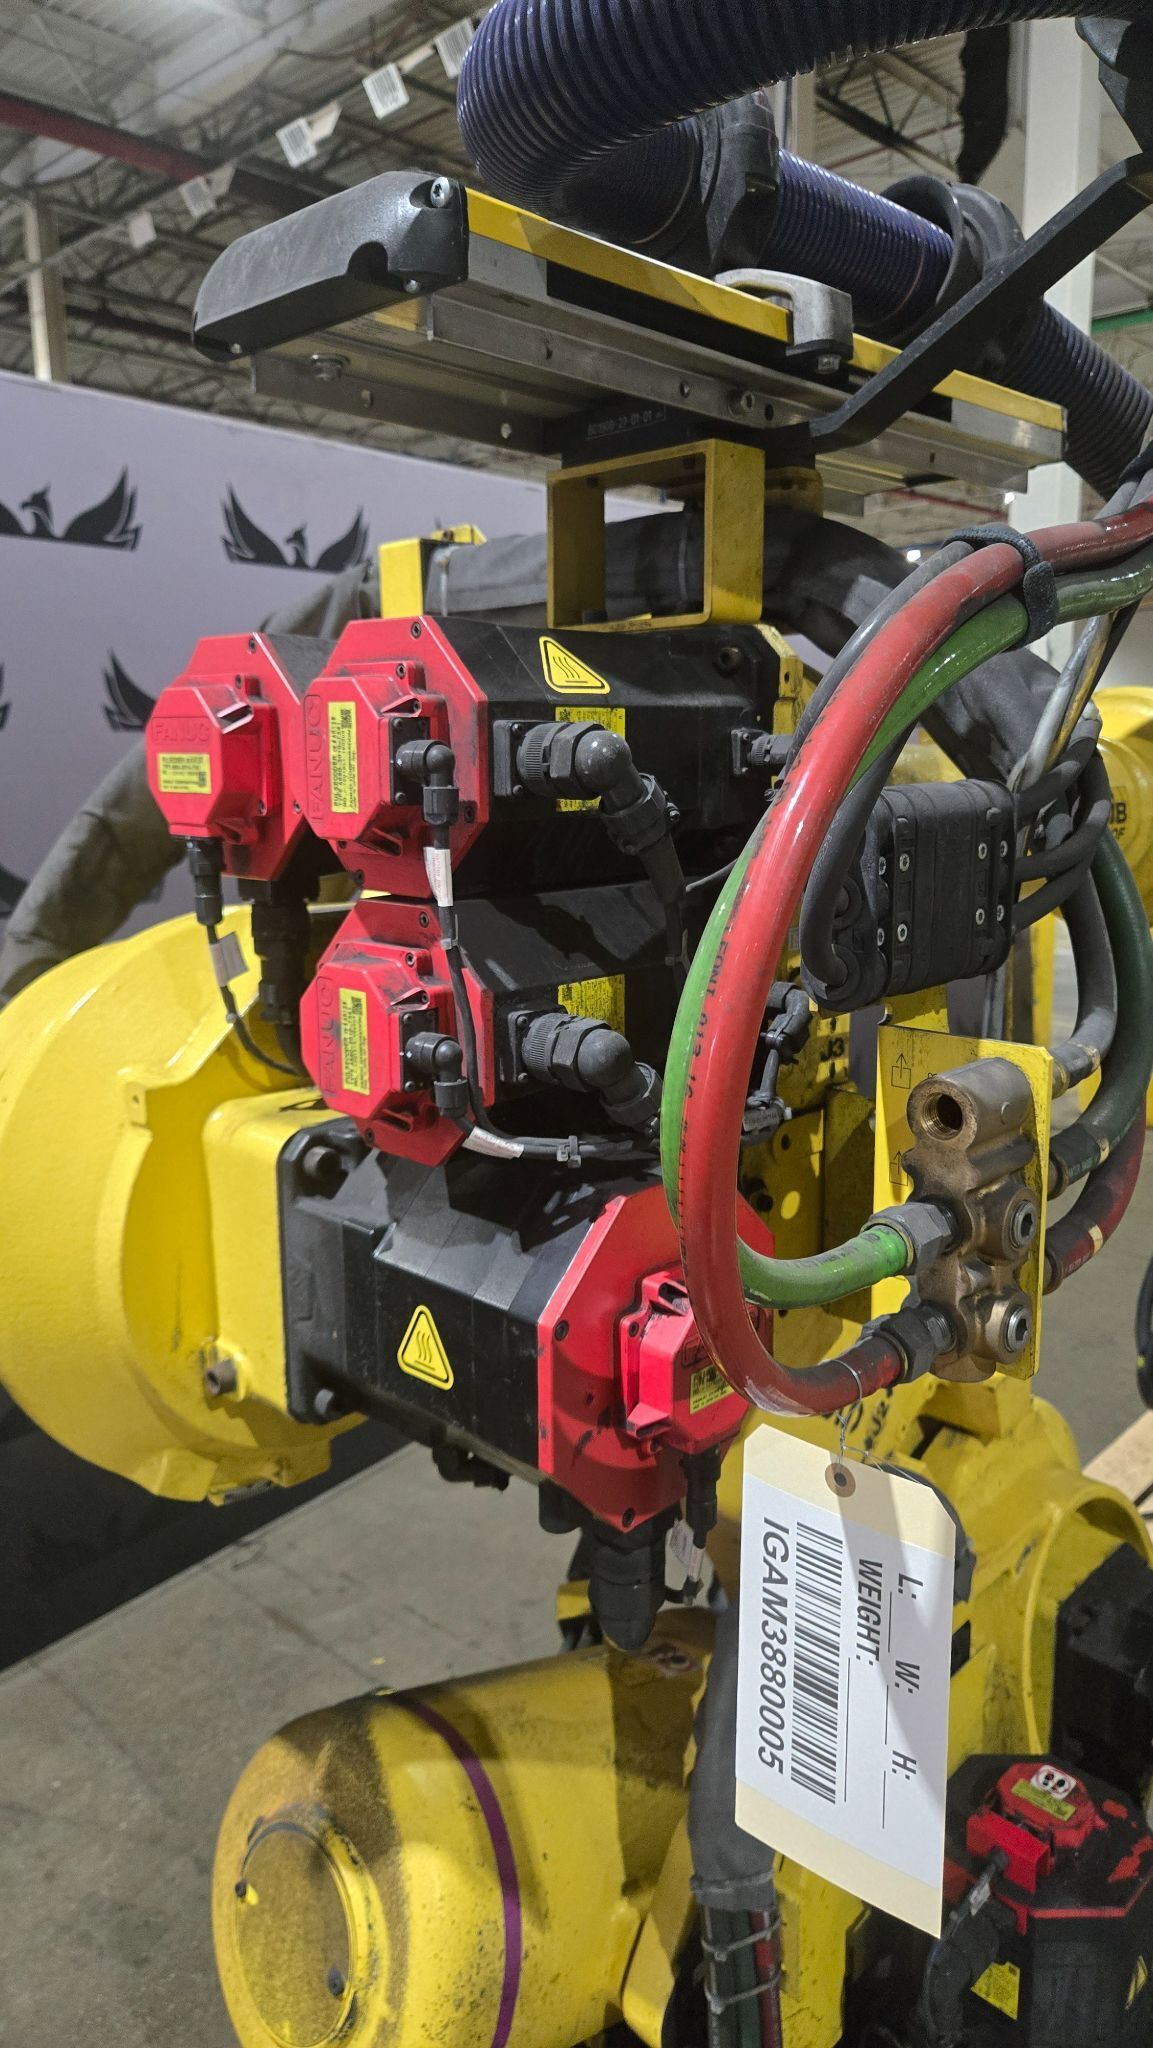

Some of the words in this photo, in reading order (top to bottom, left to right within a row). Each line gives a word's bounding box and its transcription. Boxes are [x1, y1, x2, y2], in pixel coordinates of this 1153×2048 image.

[154, 723, 211, 744] FANUC
[308, 702, 323, 820] FANUC
[319, 984, 335, 1093] FANUC
[819, 1037, 845, 1062] J3
[897, 1573, 924, 1600] L:
[855, 1559, 883, 1666] WEIGHT:
[758, 1517, 790, 1774] IGAM3880005
[893, 1660, 920, 1694] W:
[890, 1750, 917, 1780] H:
